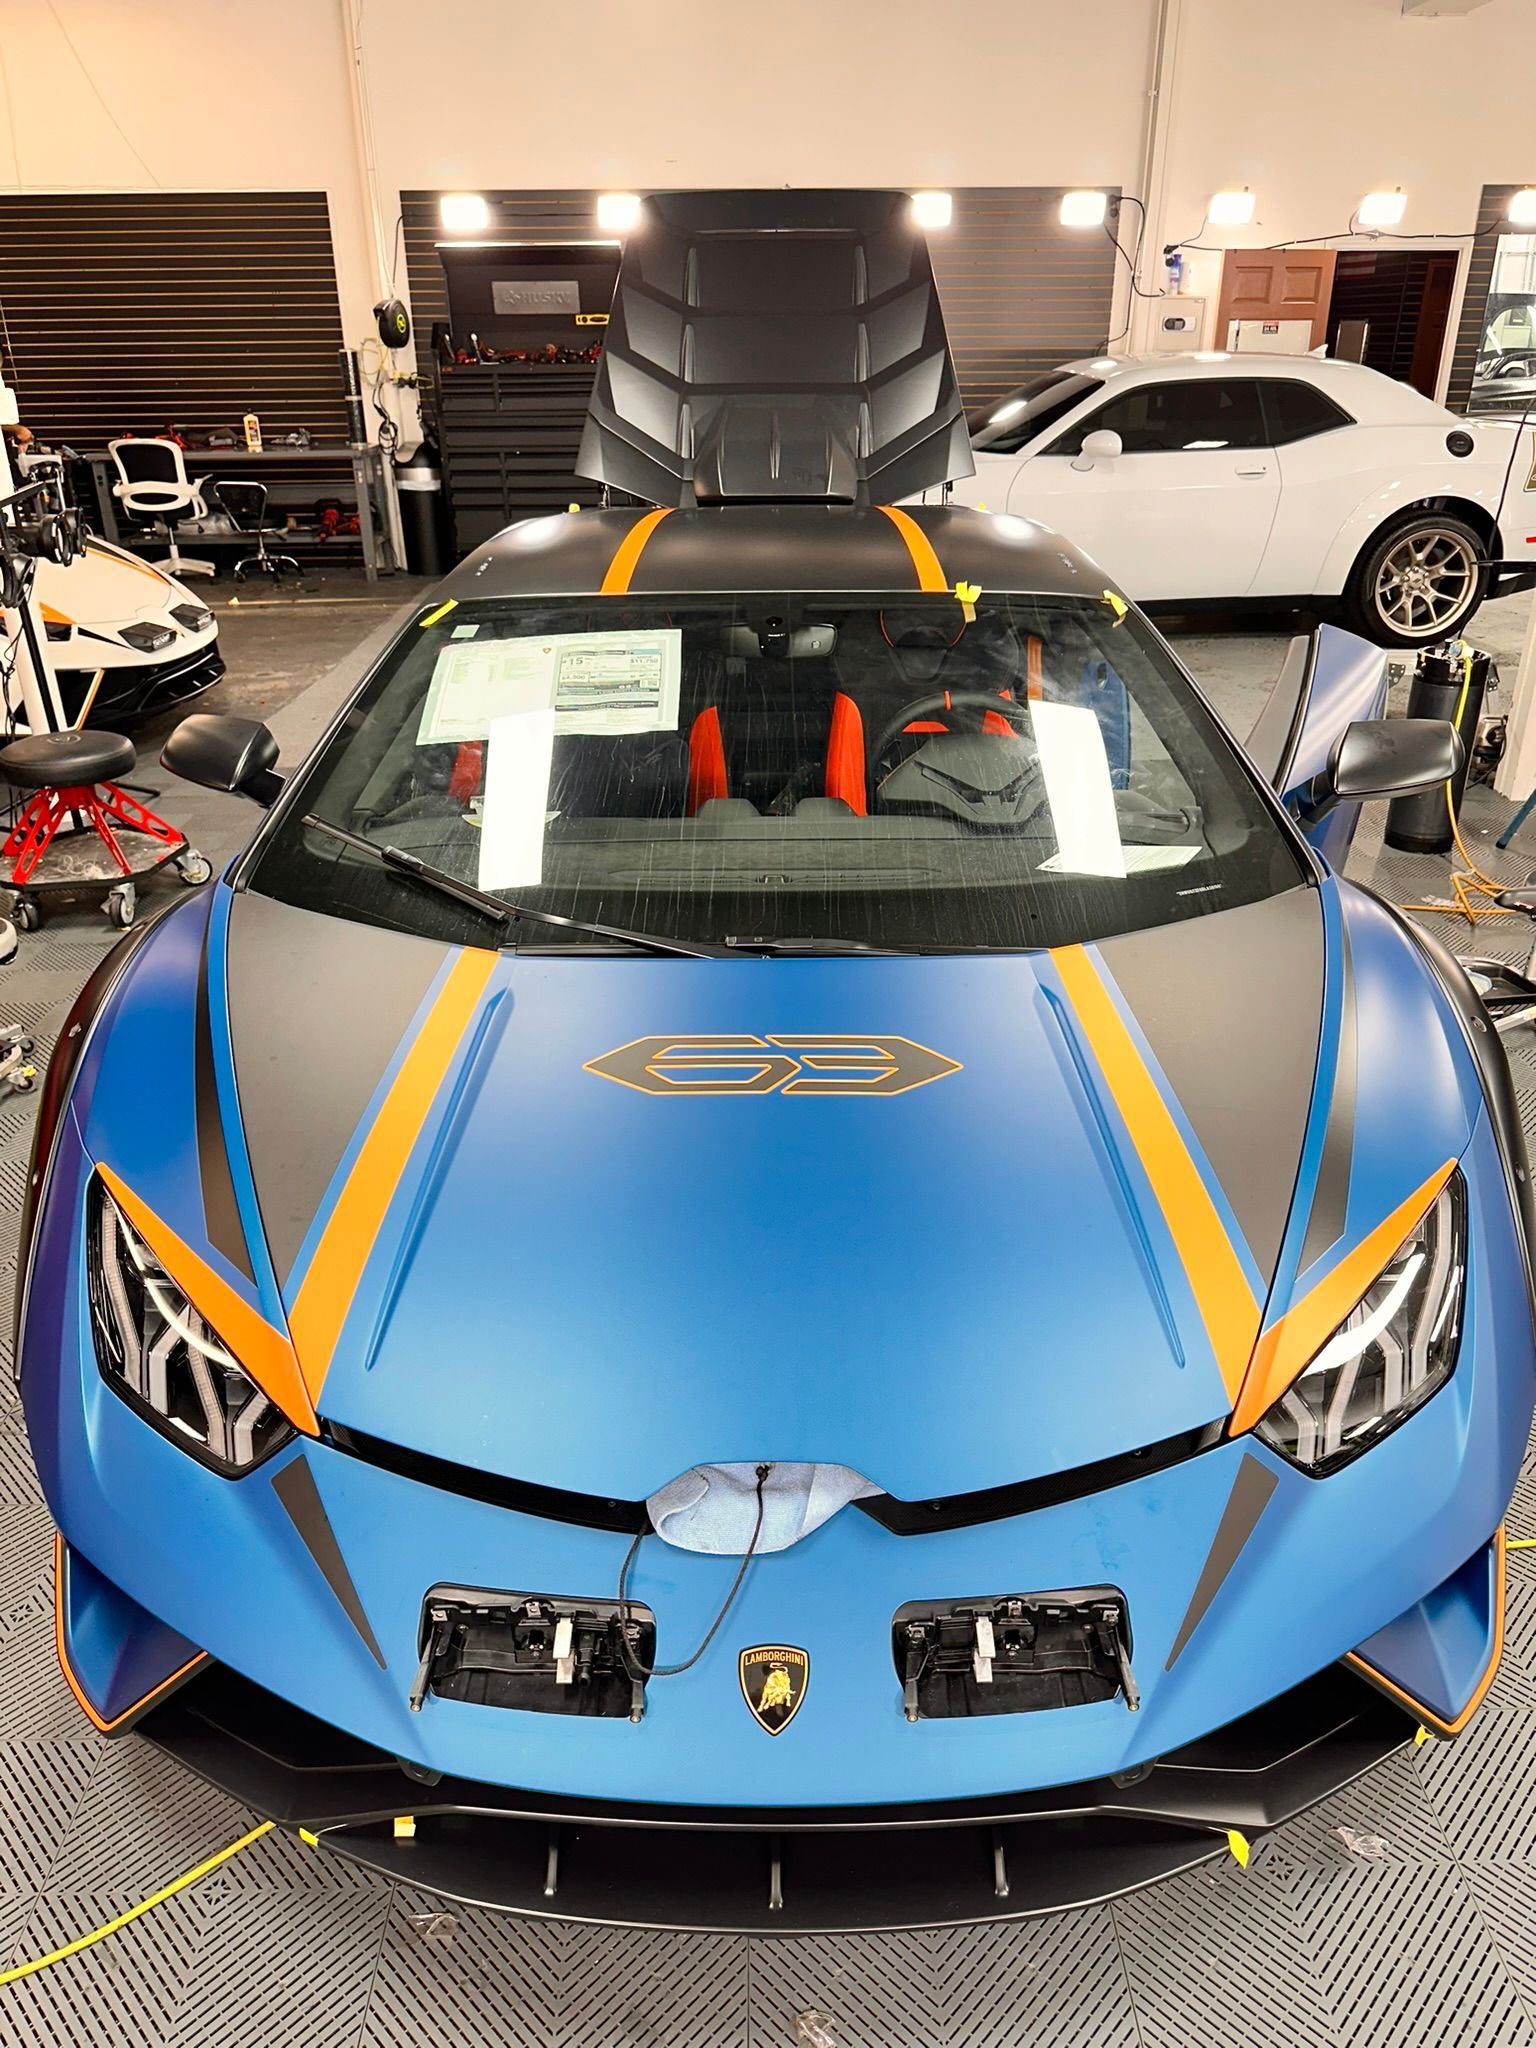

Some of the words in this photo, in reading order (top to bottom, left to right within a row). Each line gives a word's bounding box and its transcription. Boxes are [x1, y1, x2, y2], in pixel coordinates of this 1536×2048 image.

[522, 291, 571, 304] HUSKY
[582, 1034, 964, 1096] 63
[744, 1651, 804, 1666] LAMBORGHINI
